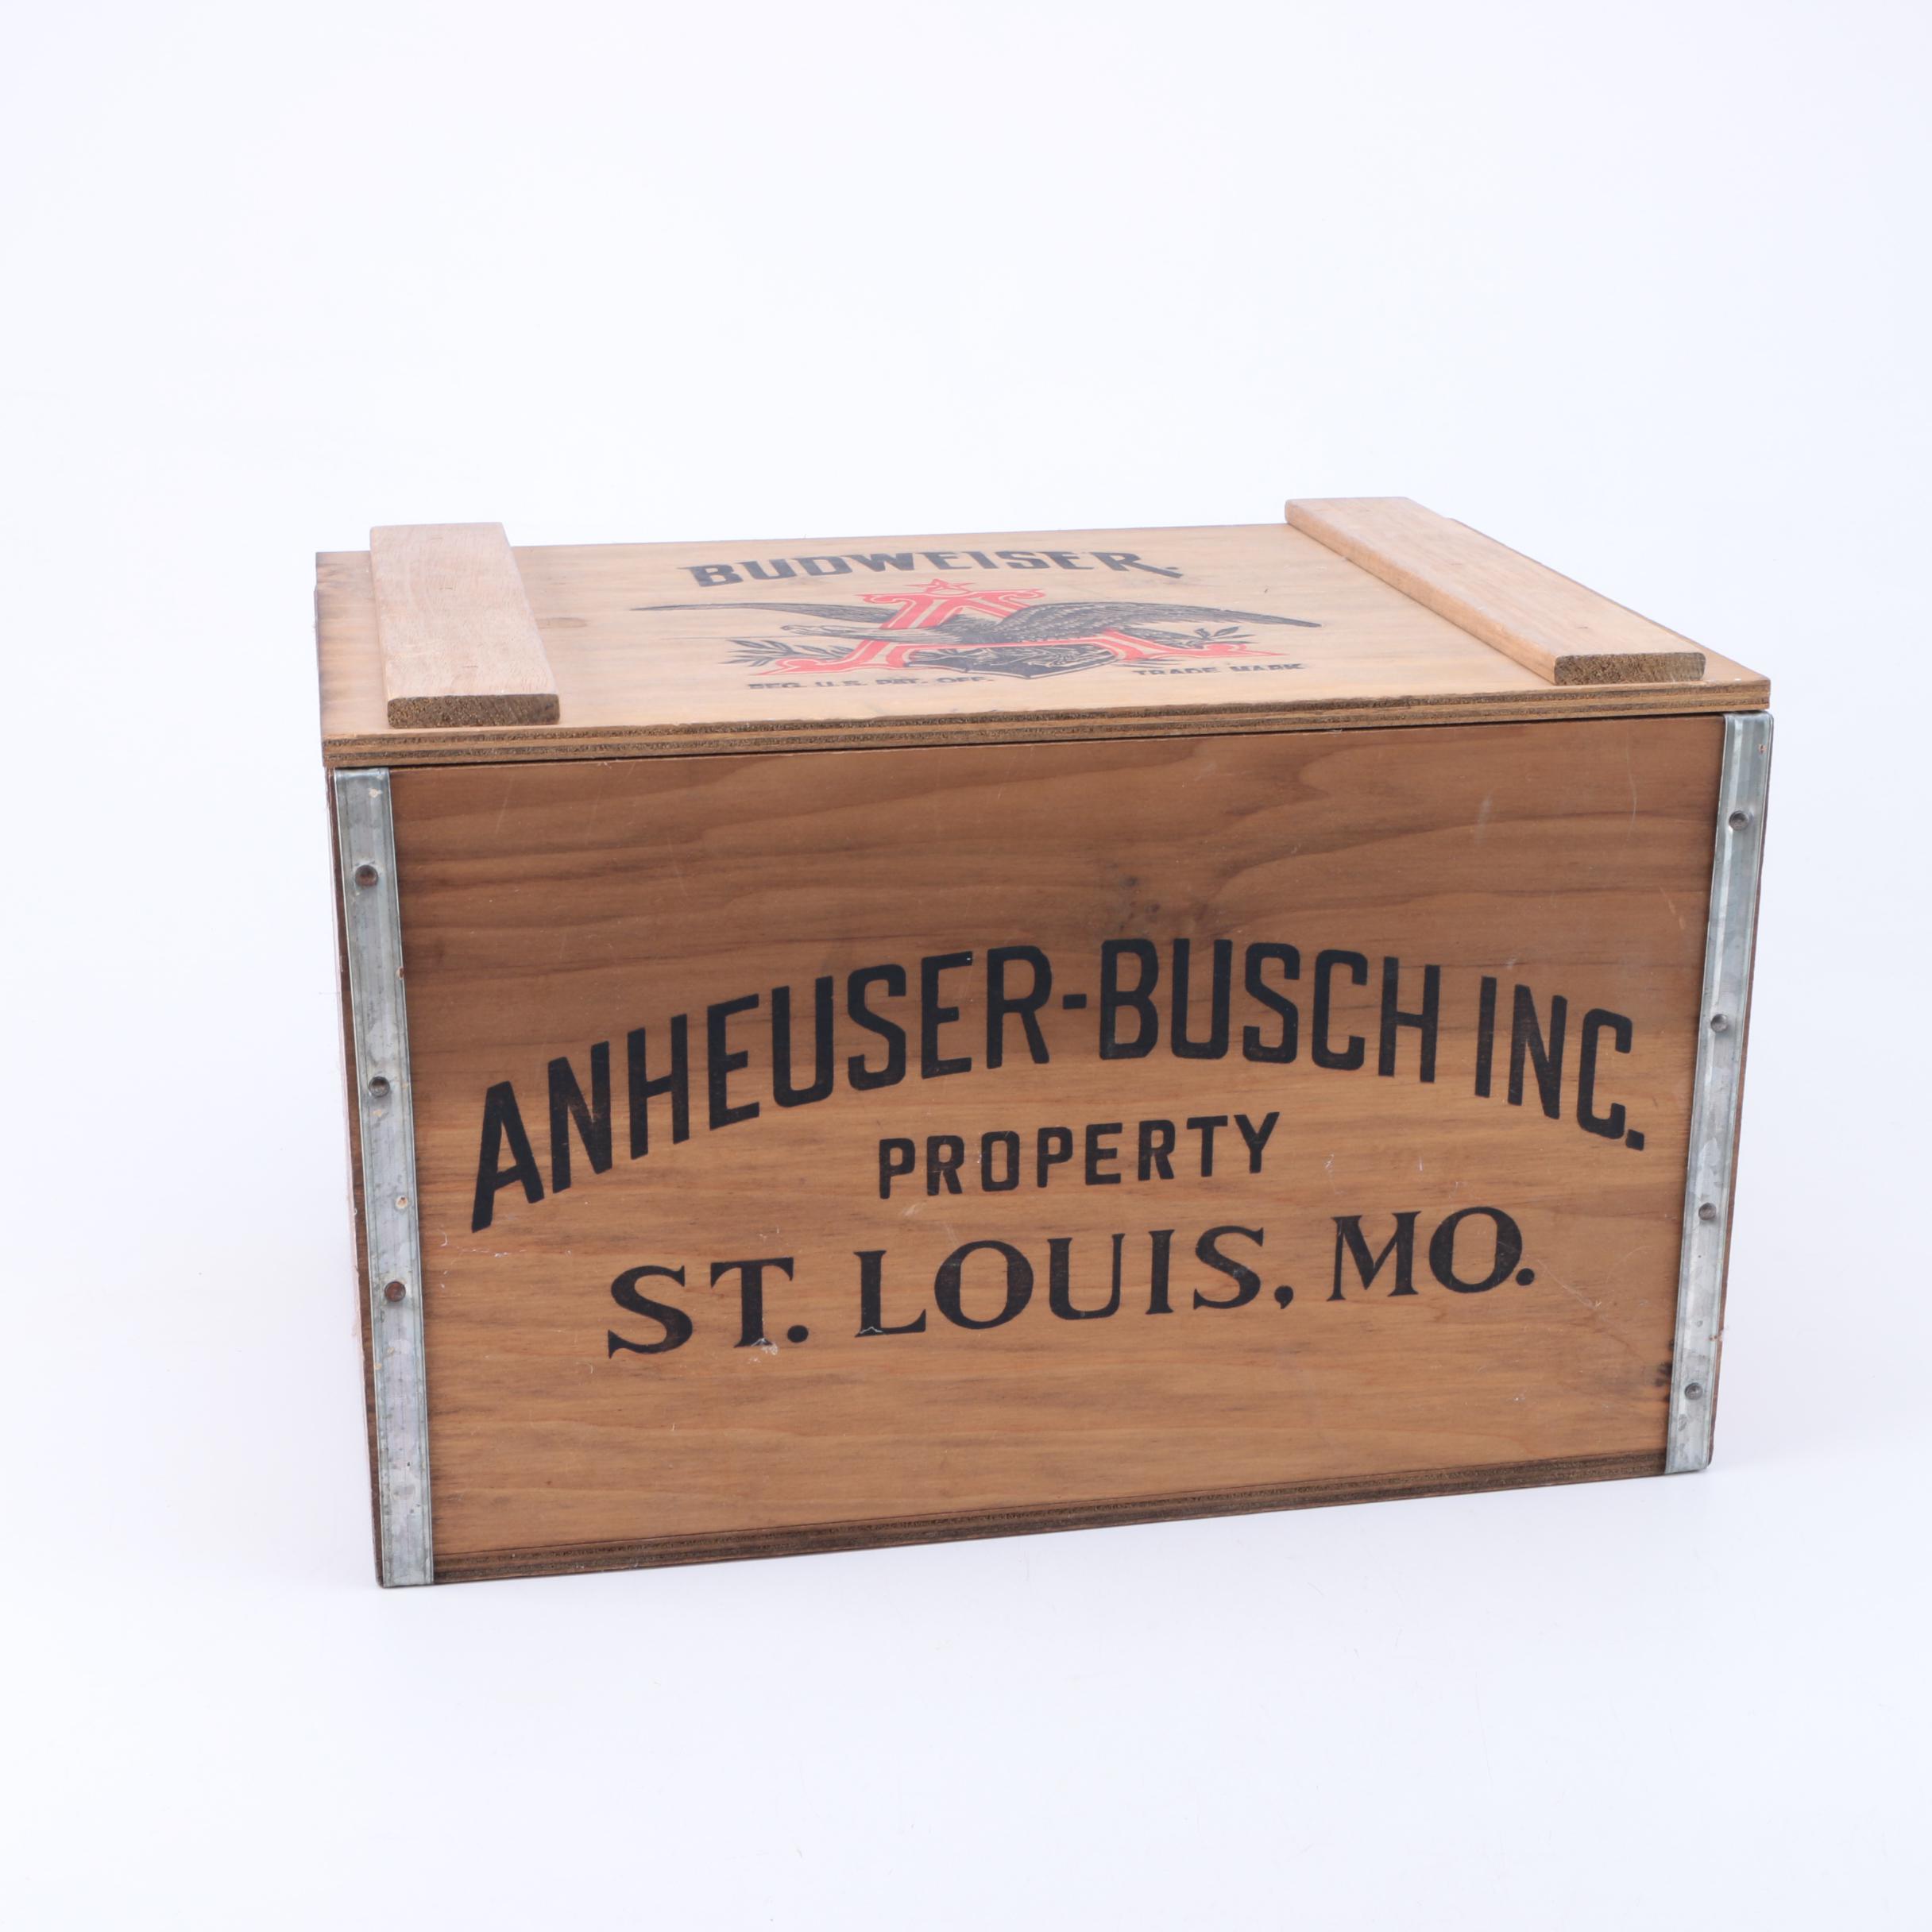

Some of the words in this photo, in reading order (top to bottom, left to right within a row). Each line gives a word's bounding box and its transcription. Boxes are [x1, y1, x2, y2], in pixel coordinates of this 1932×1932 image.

[1132, 667, 1221, 676] TRADE
[1229, 663, 1304, 672] MARK
[472, 937, 1440, 1232] ANHEUSER-BUSCH
[1476, 977, 1644, 1151] INC.
[879, 1112, 1280, 1200] PROPERTY
[608, 1257, 809, 1358] ST.
[856, 1226, 1293, 1337] LOUIS,
[1329, 1207, 1535, 1300] MO.
